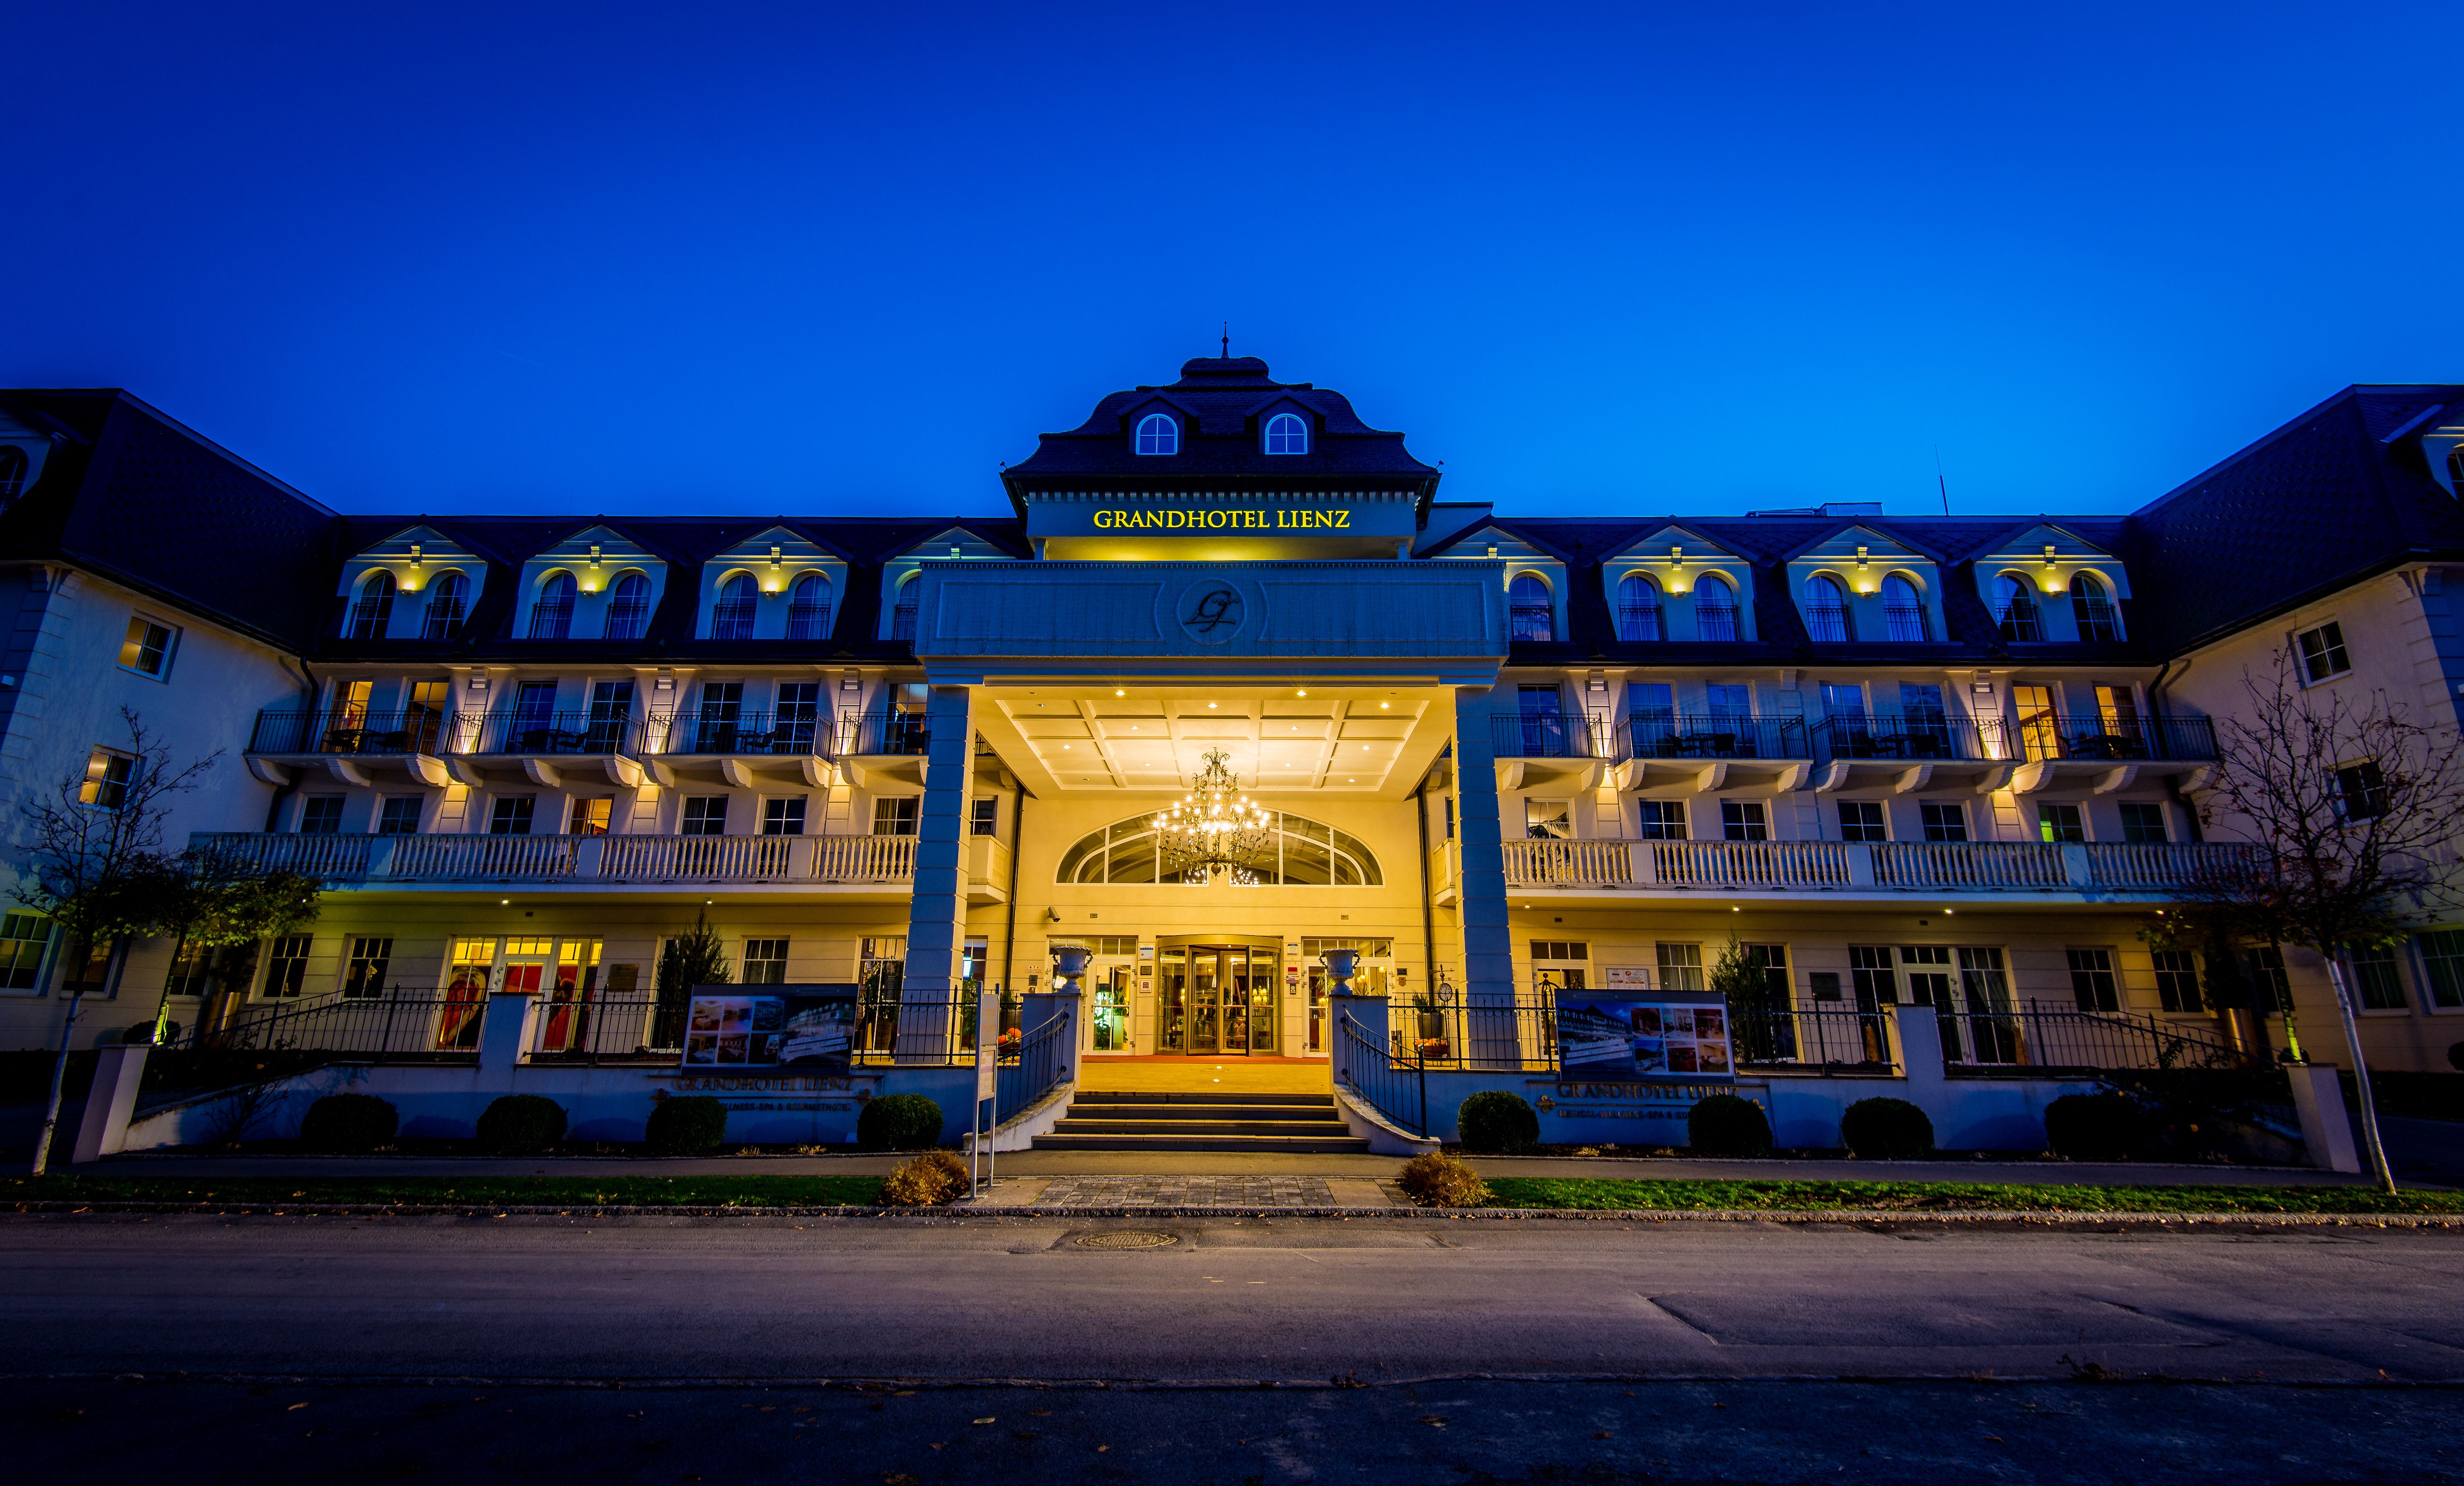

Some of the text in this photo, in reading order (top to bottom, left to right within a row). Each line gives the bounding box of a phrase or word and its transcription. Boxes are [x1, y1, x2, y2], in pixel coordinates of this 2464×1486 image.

[1094, 510, 1350, 528] GRANDHOTEL LIENZ
[675, 1077, 852, 1091] GRANDHOTEL LIENZ
[1558, 1084, 1683, 1099] GRANDHOTEL
